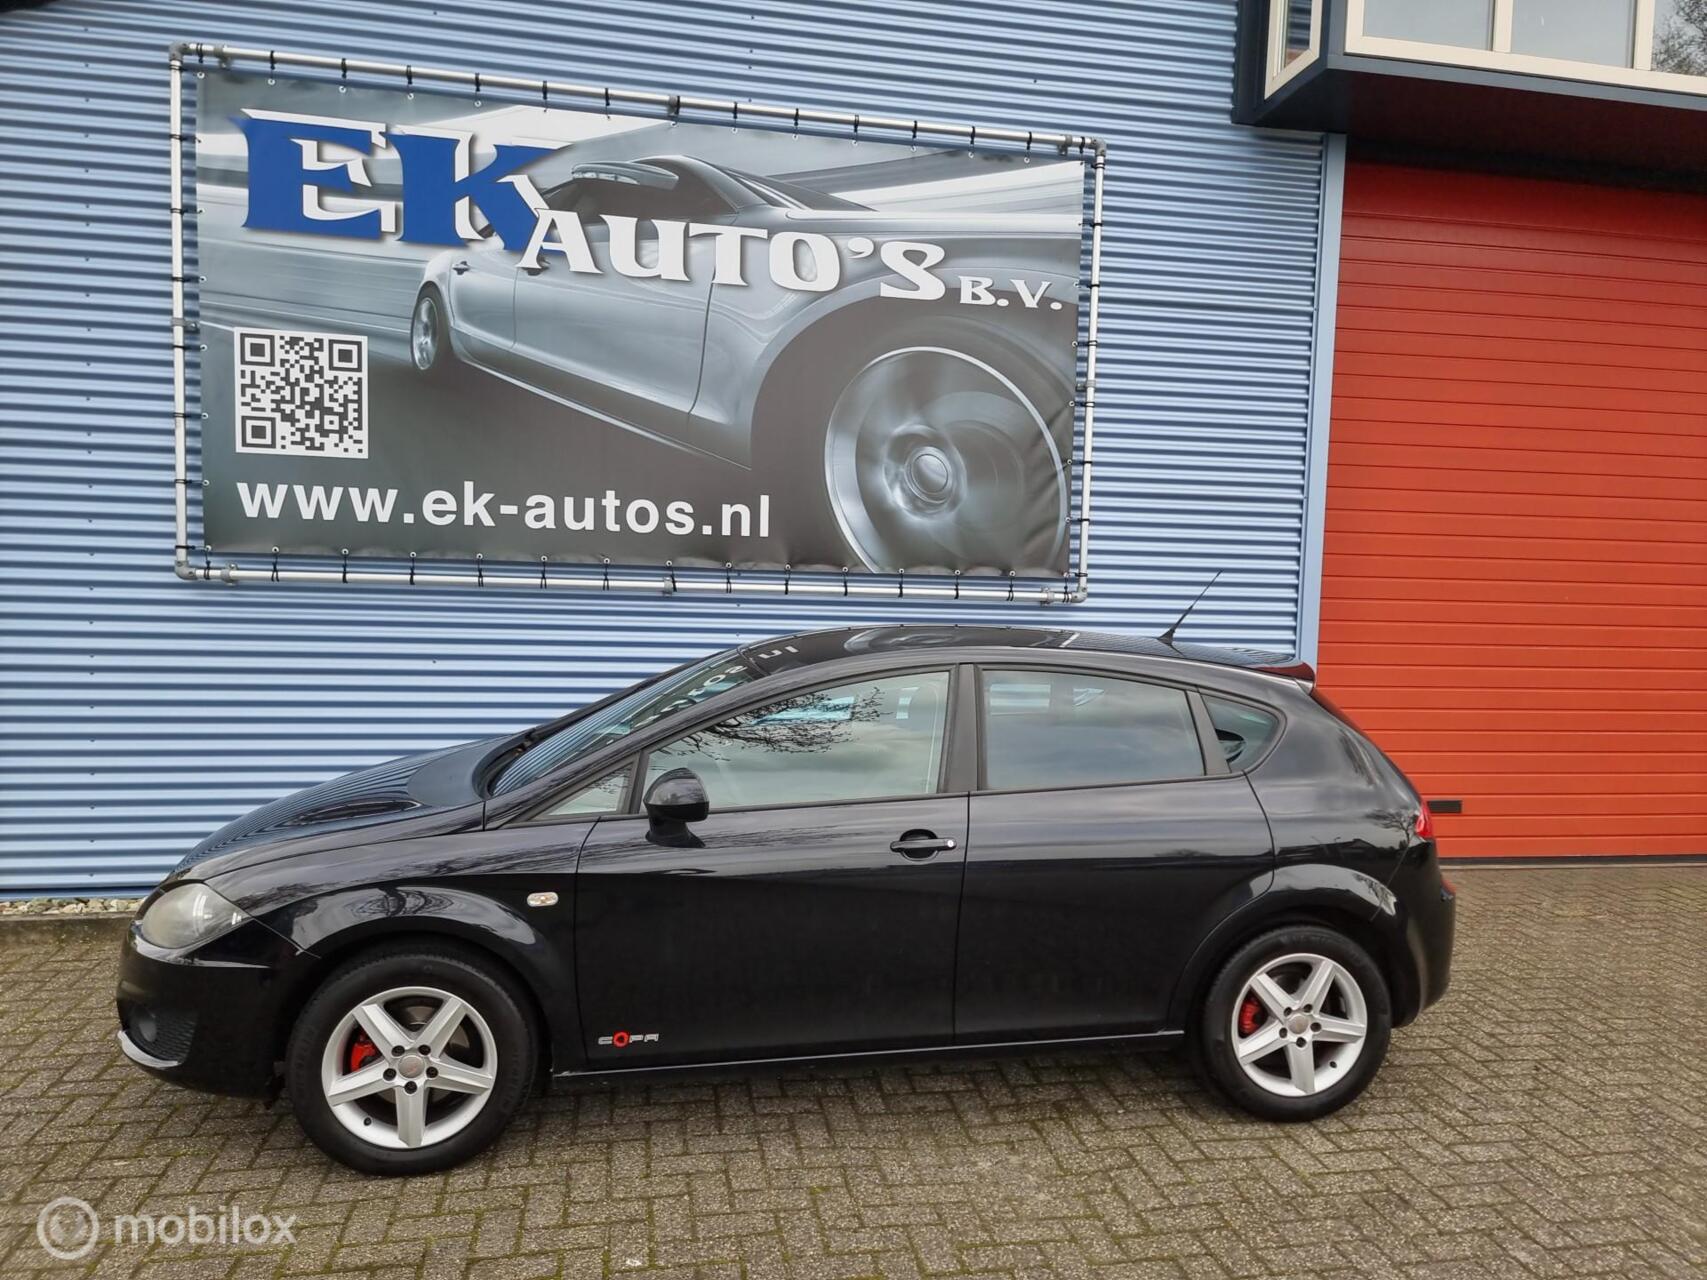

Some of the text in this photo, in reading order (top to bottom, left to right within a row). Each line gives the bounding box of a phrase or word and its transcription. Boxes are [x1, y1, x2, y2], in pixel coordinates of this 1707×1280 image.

[230, 109, 572, 253] EK
[959, 275, 1063, 310] B.V.
[236, 481, 771, 538] www.ek-autos.nl
[598, 1031, 660, 1048] COPA
